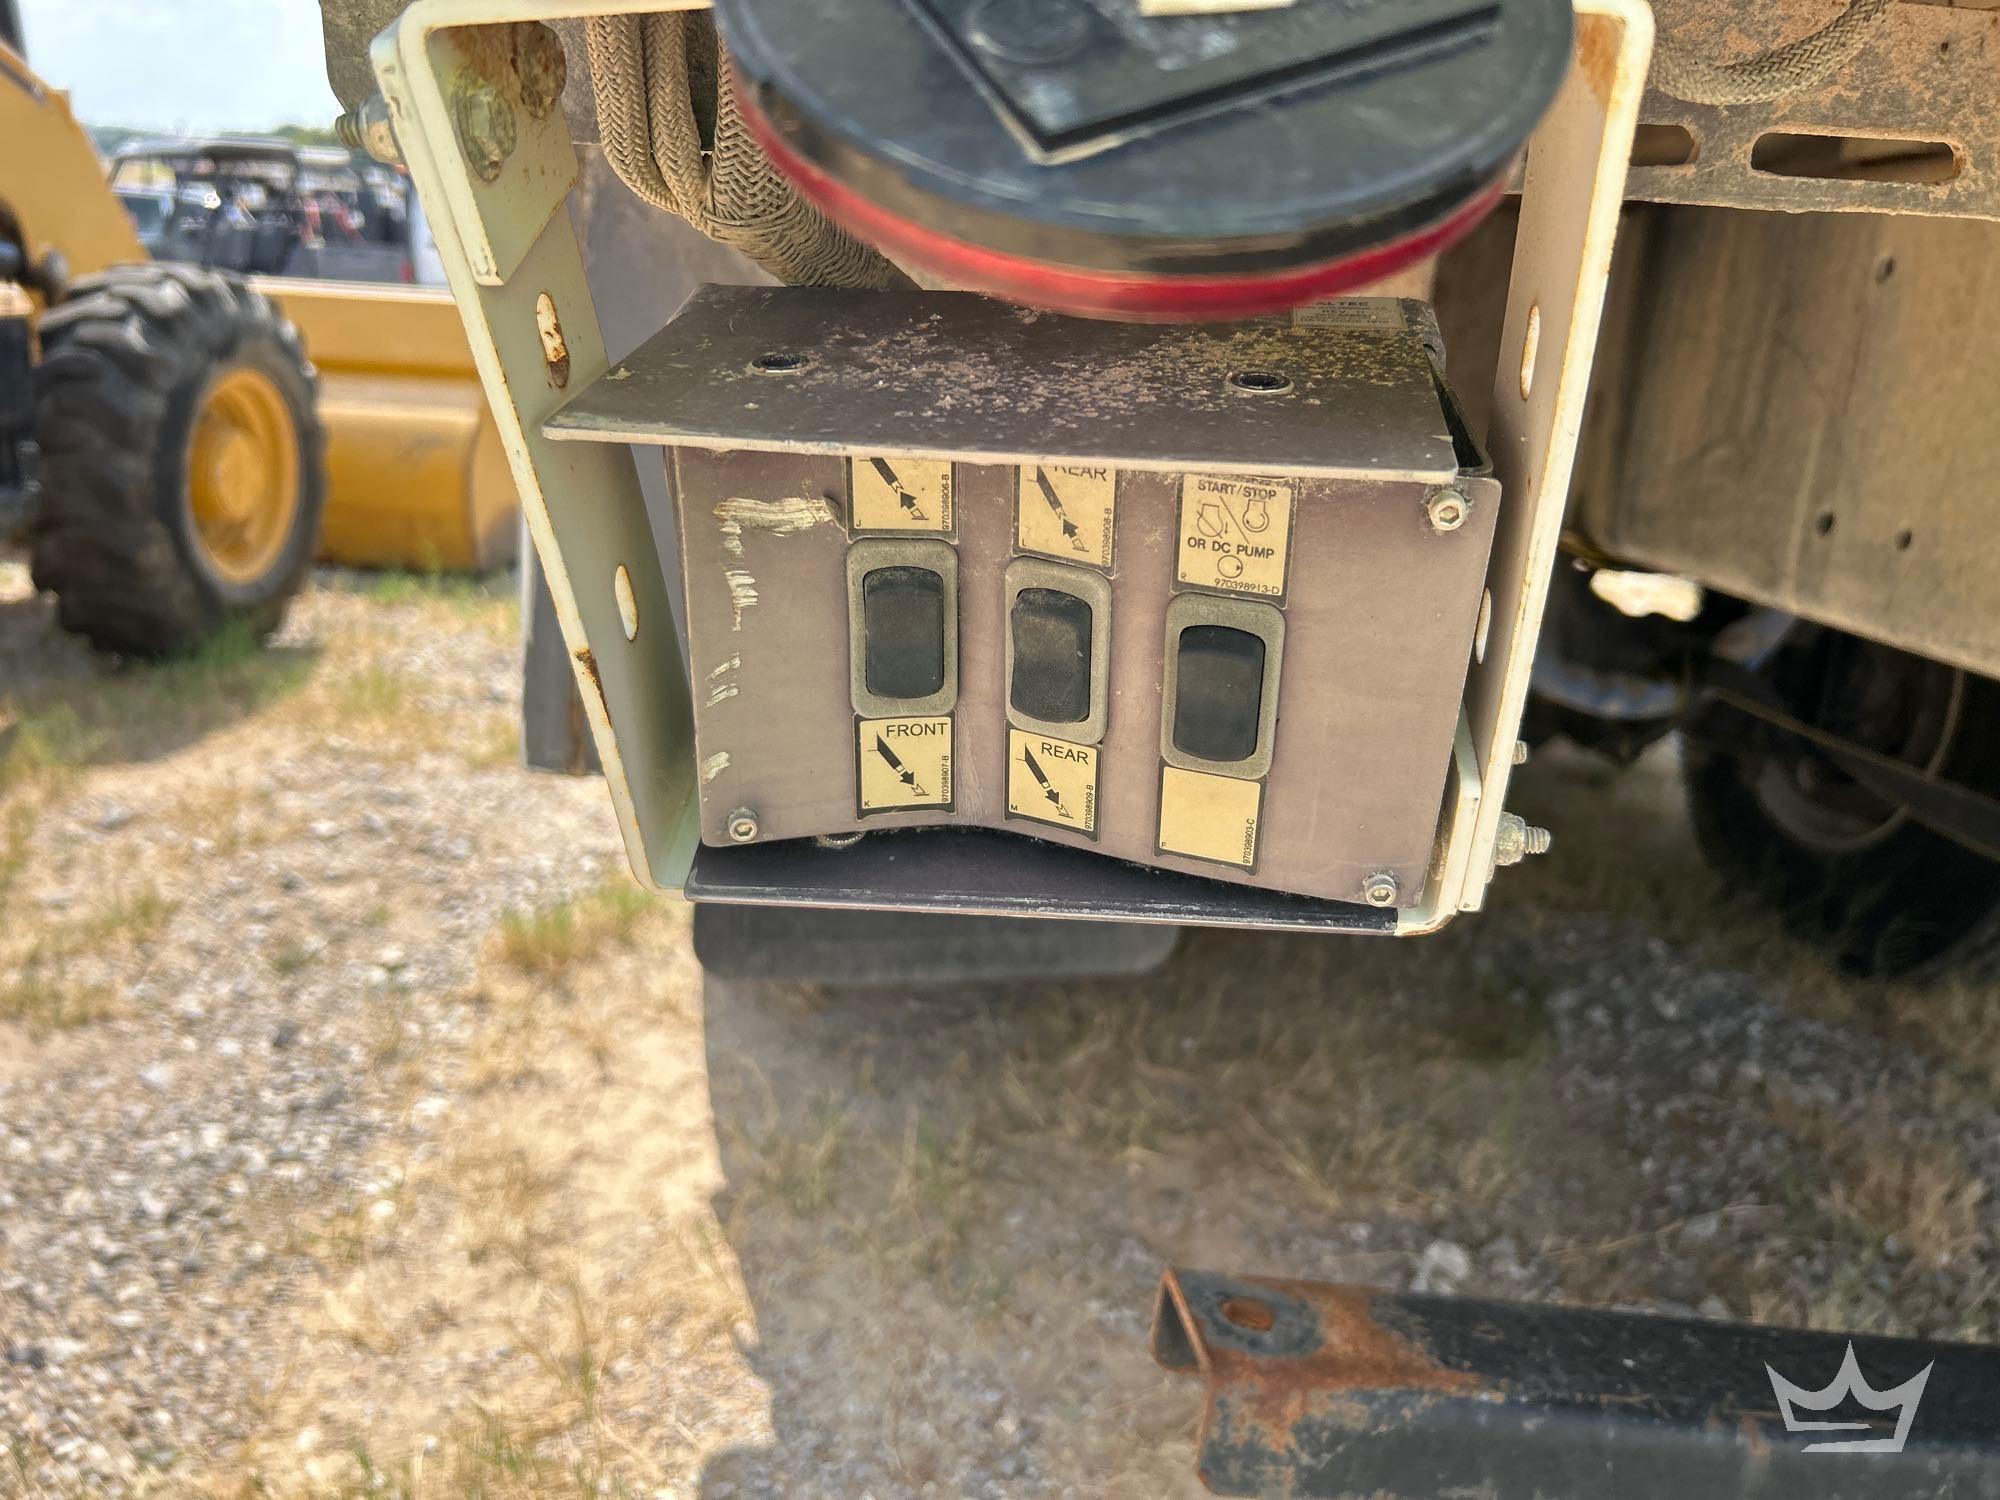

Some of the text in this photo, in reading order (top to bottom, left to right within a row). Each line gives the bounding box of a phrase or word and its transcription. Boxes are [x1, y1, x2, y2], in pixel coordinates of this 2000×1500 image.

[1197, 480, 1277, 500] START/STOP
[856, 519, 861, 527] J
[1021, 538, 1026, 547] L
[1187, 536, 1275, 559] OR DC PUMP
[1214, 578, 1280, 594] 970398913-D
[886, 722, 948, 737] FRONT
[1041, 742, 1089, 765] REAR
[1010, 803, 1018, 811] M
[1084, 784, 1094, 830] 970398909-B
[1242, 818, 1255, 864] 970398903-C
